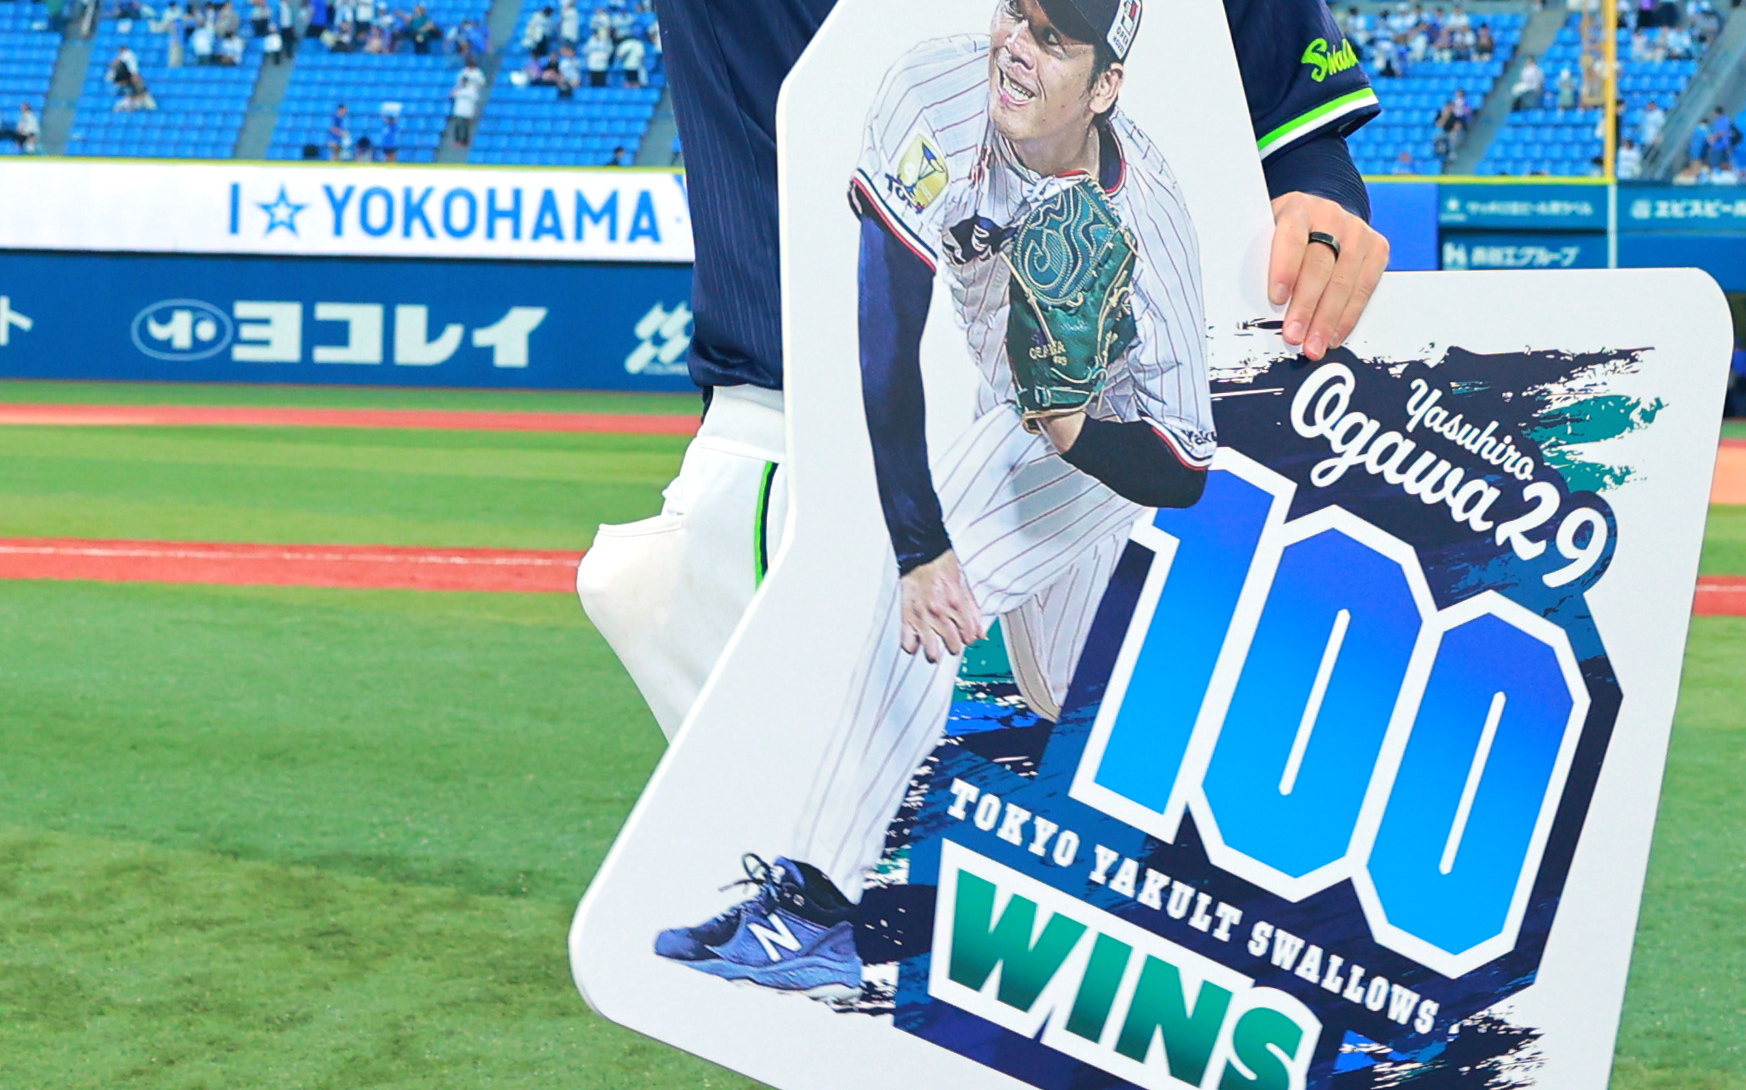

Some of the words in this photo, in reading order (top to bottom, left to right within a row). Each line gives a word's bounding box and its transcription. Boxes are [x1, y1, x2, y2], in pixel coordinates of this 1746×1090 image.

[228, 182, 240, 235] I
[323, 184, 662, 243] YOKOHAMA
[232, 301, 547, 368] ヨコレイ
[1406, 378, 1535, 481] Yasuhiro
[1290, 362, 1501, 532] Ogawa
[1496, 481, 1608, 588] 29
[1070, 450, 1590, 978] 100
[942, 862, 1306, 1090] WINS
[946, 778, 1080, 867] TOKYO
[1088, 844, 1242, 942] YAKULT
[1247, 922, 1441, 1035] SWALLOWS
